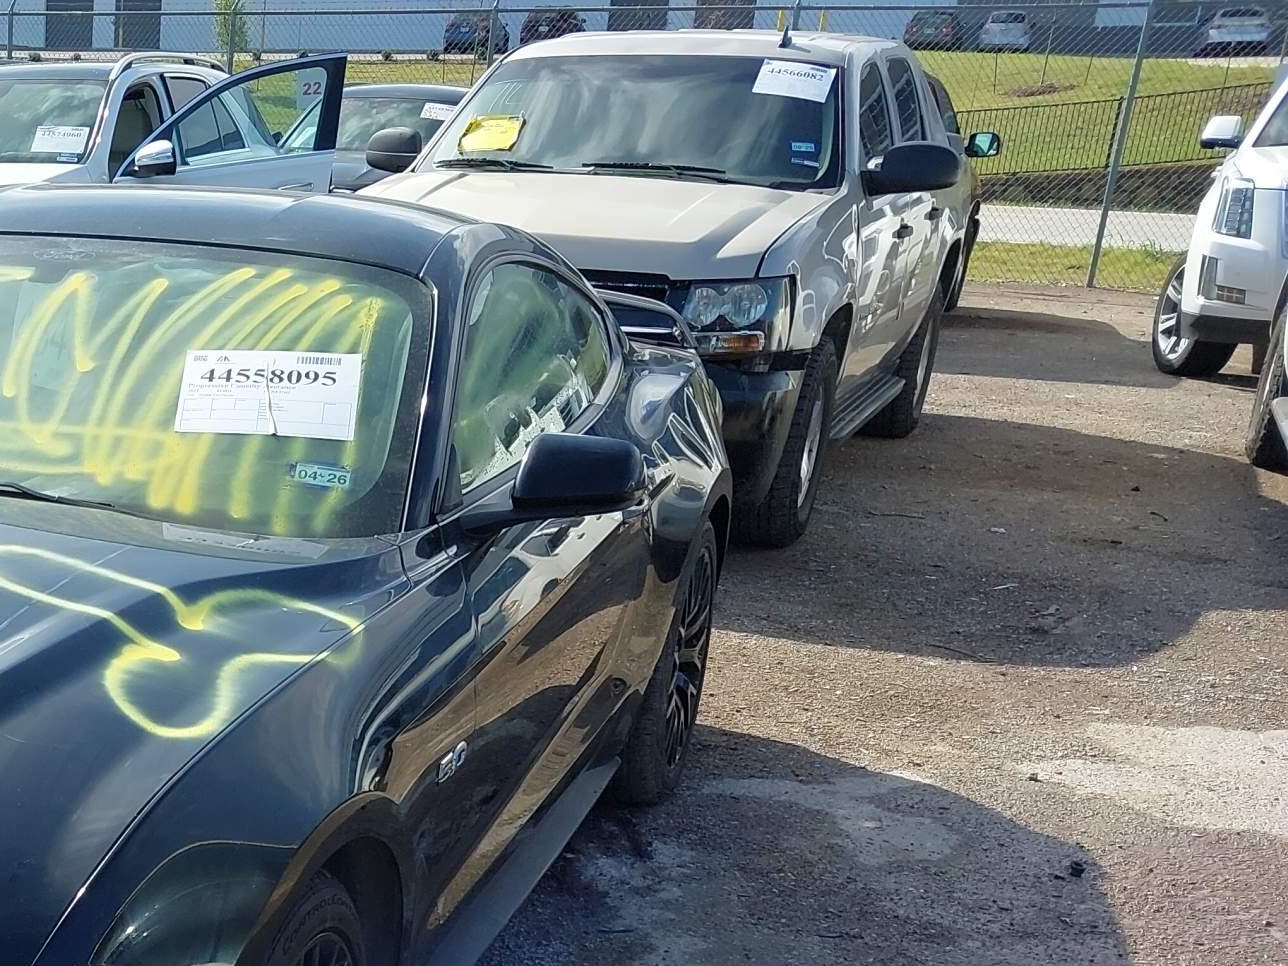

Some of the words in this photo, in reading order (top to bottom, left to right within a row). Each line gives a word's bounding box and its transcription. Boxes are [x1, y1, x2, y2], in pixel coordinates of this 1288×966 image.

[767, 68, 824, 82] 44566082
[302, 81, 322, 96] 22
[200, 368, 337, 386] 44558095
[298, 469, 318, 481] 04
[326, 473, 347, 485] 26
